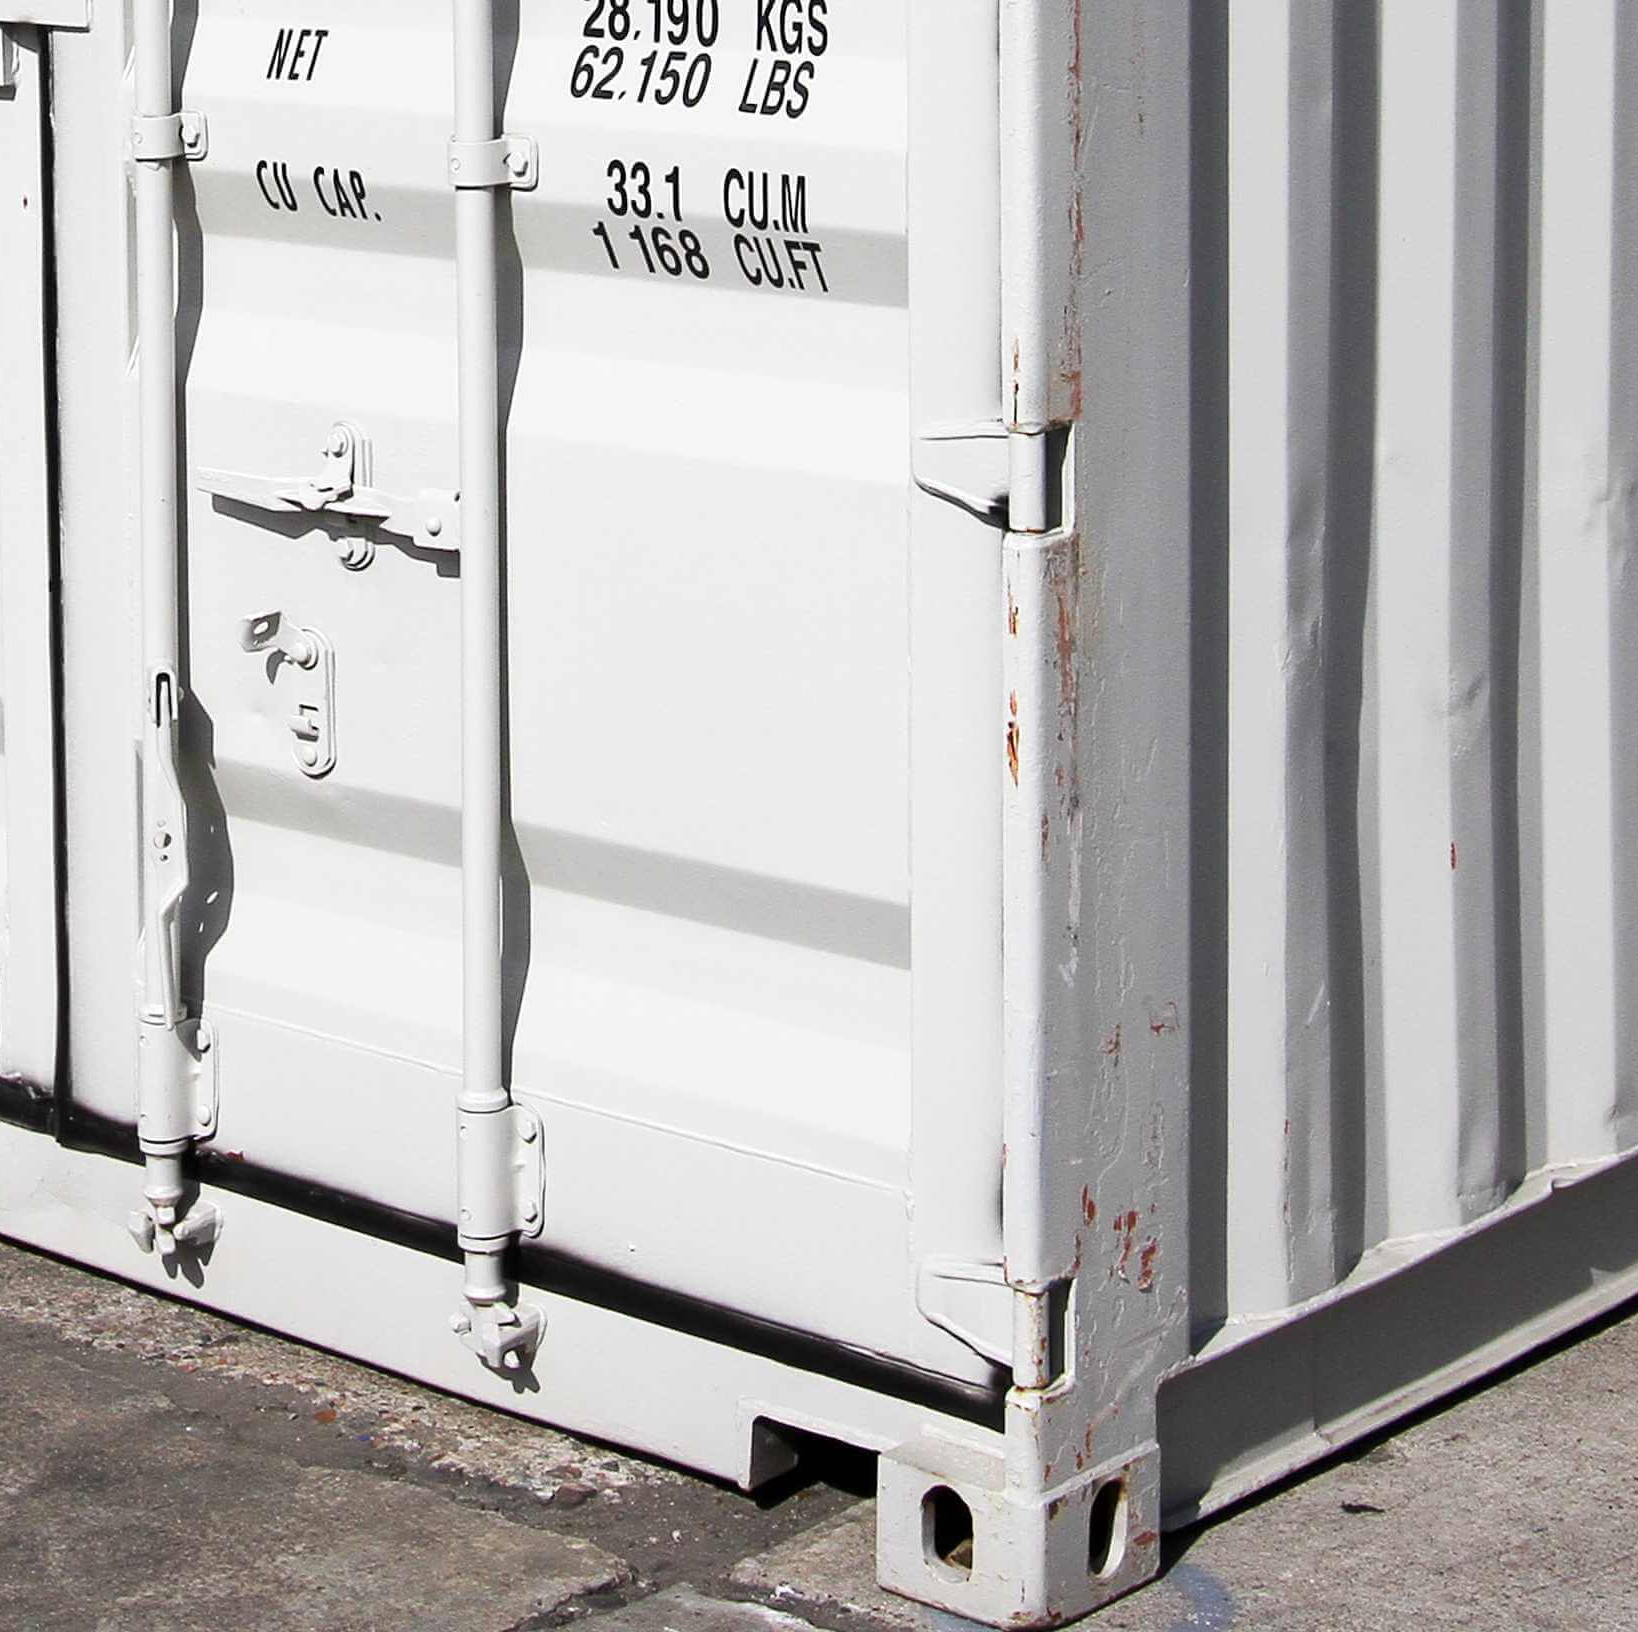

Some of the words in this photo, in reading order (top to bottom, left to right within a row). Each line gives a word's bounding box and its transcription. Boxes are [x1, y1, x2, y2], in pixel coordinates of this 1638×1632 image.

[266, 28, 329, 81] NET
[738, 59, 815, 119] LBS
[256, 159, 298, 212] CU
[313, 166, 382, 222] CAP.
[607, 159, 683, 222] 33.1
